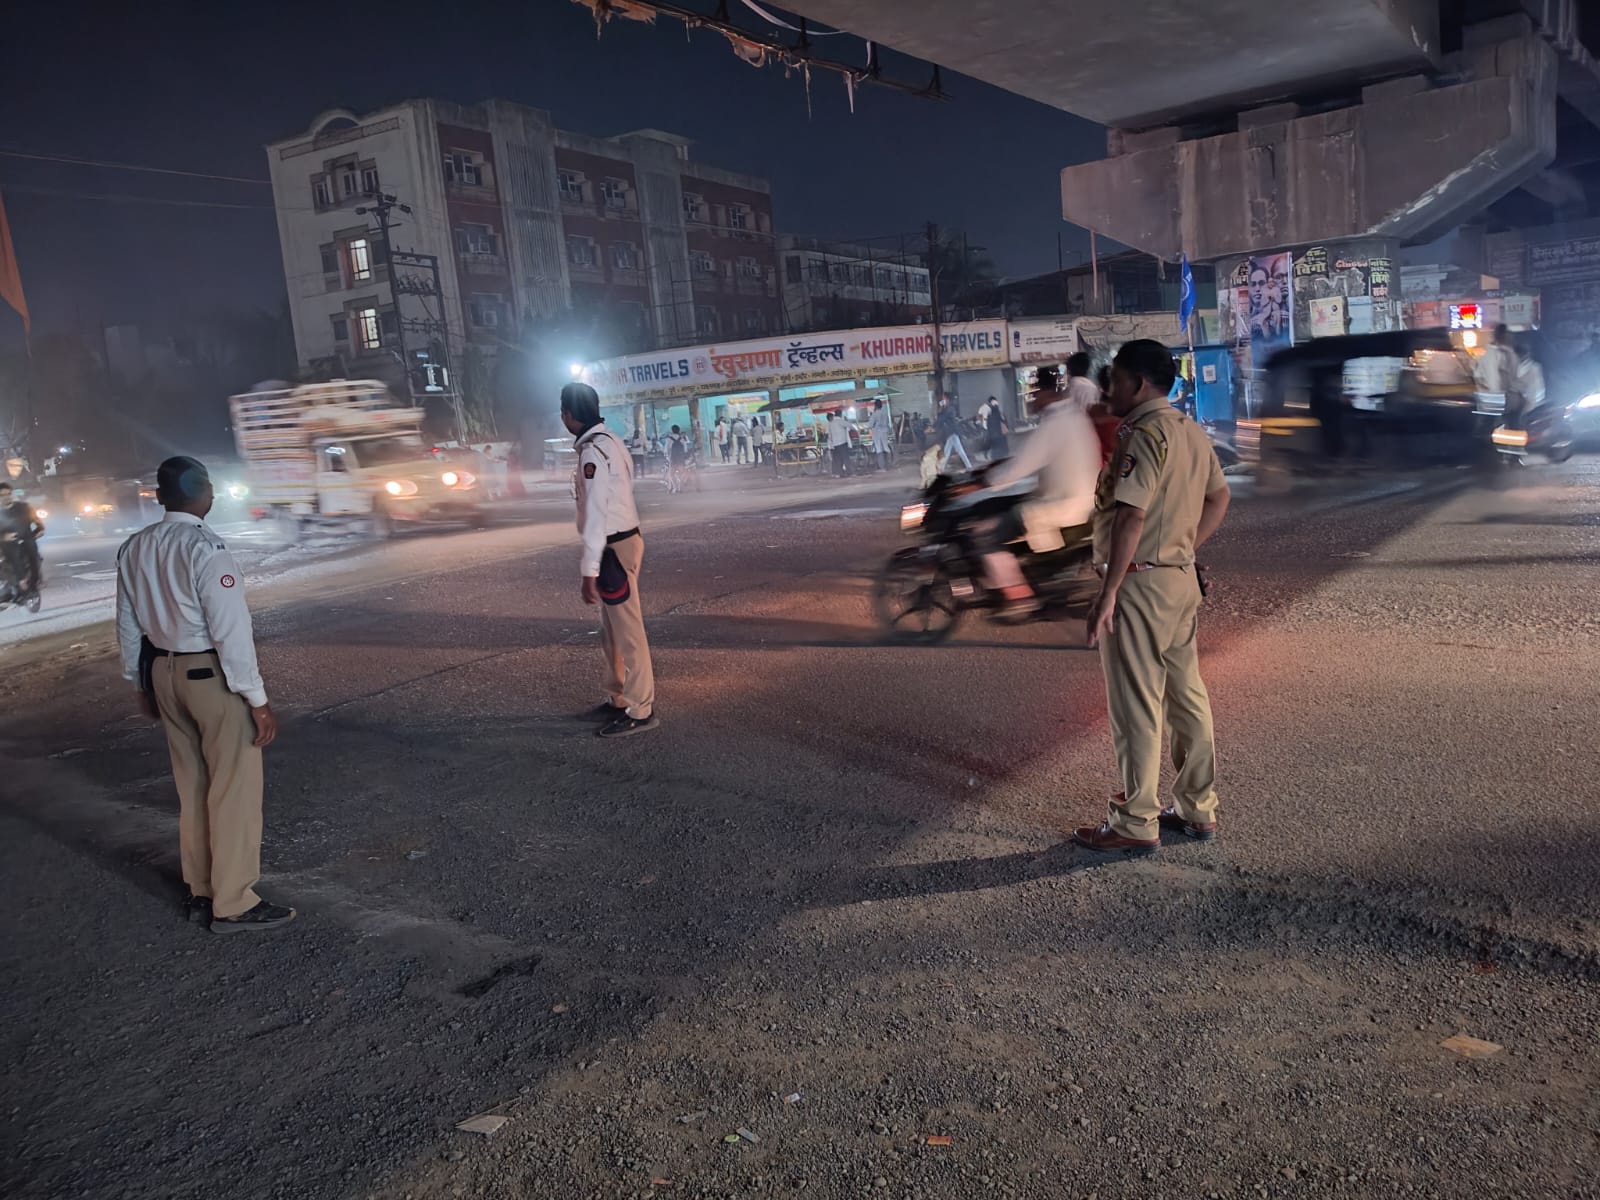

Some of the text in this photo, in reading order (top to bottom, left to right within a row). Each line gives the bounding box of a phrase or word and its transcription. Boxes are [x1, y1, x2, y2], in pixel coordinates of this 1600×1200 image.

[860, 330, 1002, 360] KHURANA TRAVELS
[628, 358, 690, 384] TRAVELS
